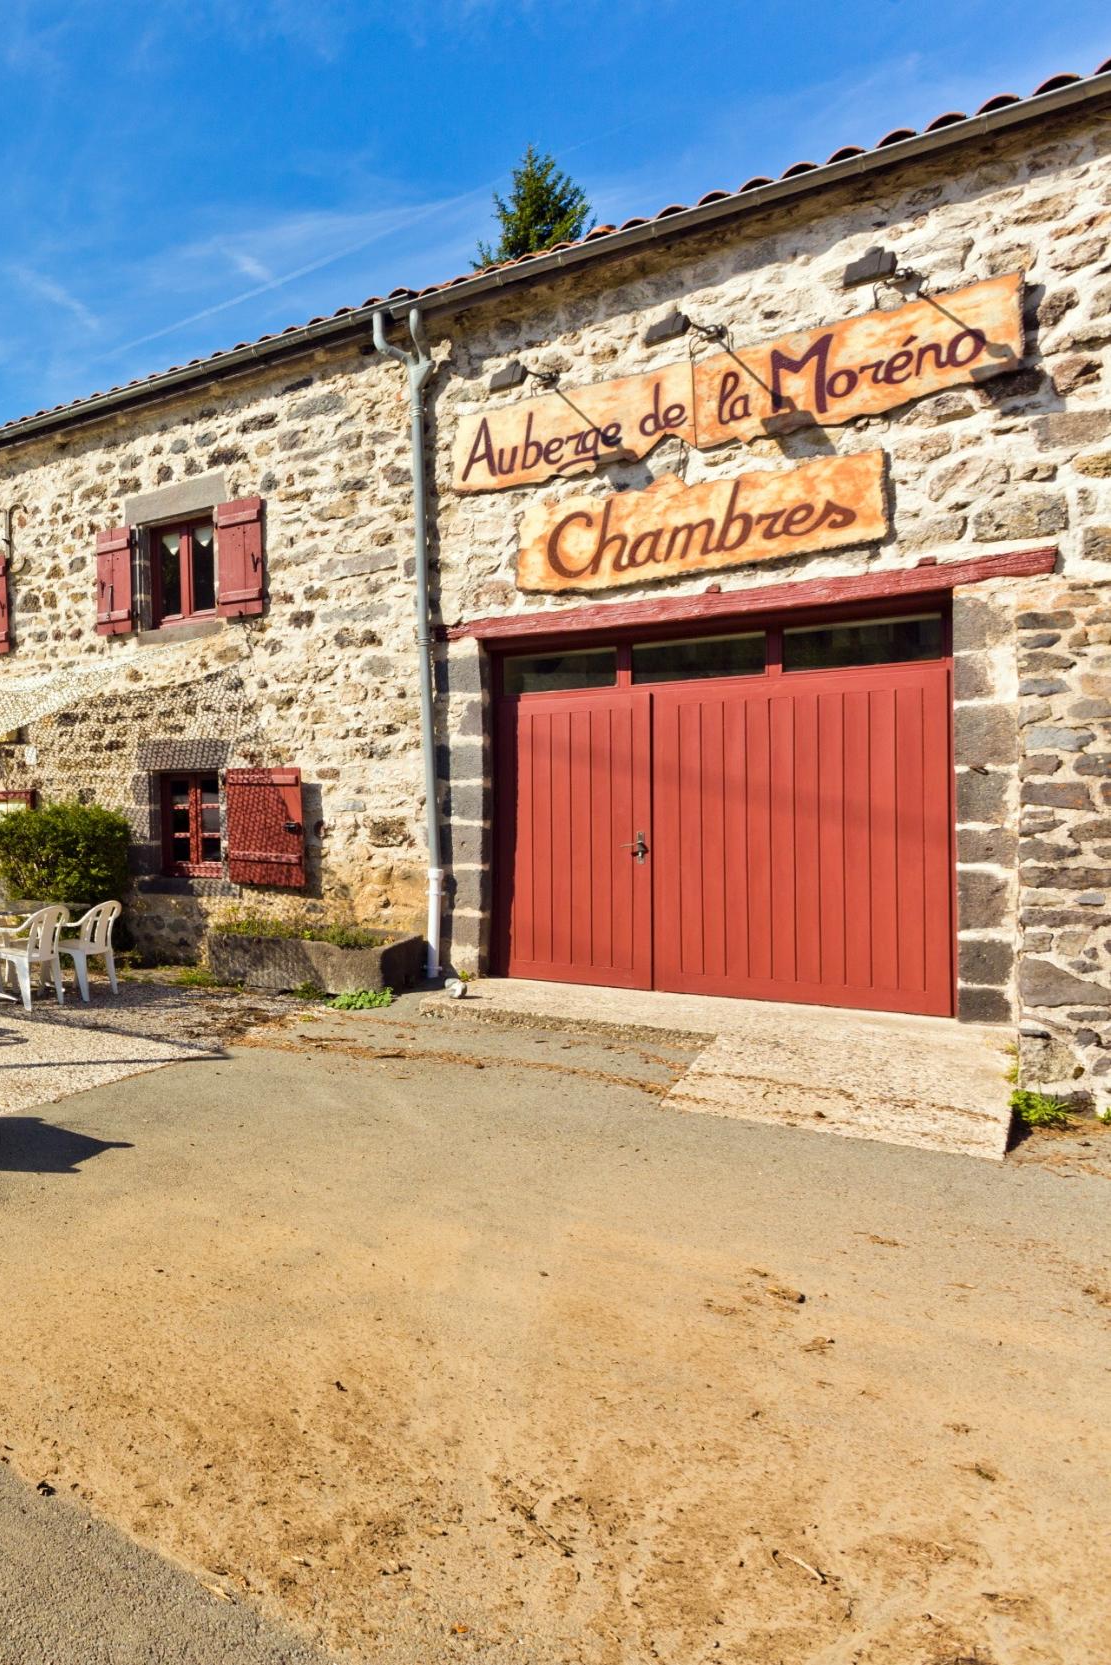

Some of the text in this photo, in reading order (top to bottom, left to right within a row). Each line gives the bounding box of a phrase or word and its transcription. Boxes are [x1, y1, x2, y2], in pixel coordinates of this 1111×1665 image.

[461, 328, 987, 473] Auberge de la Moréno
[546, 480, 858, 578] Chambres
